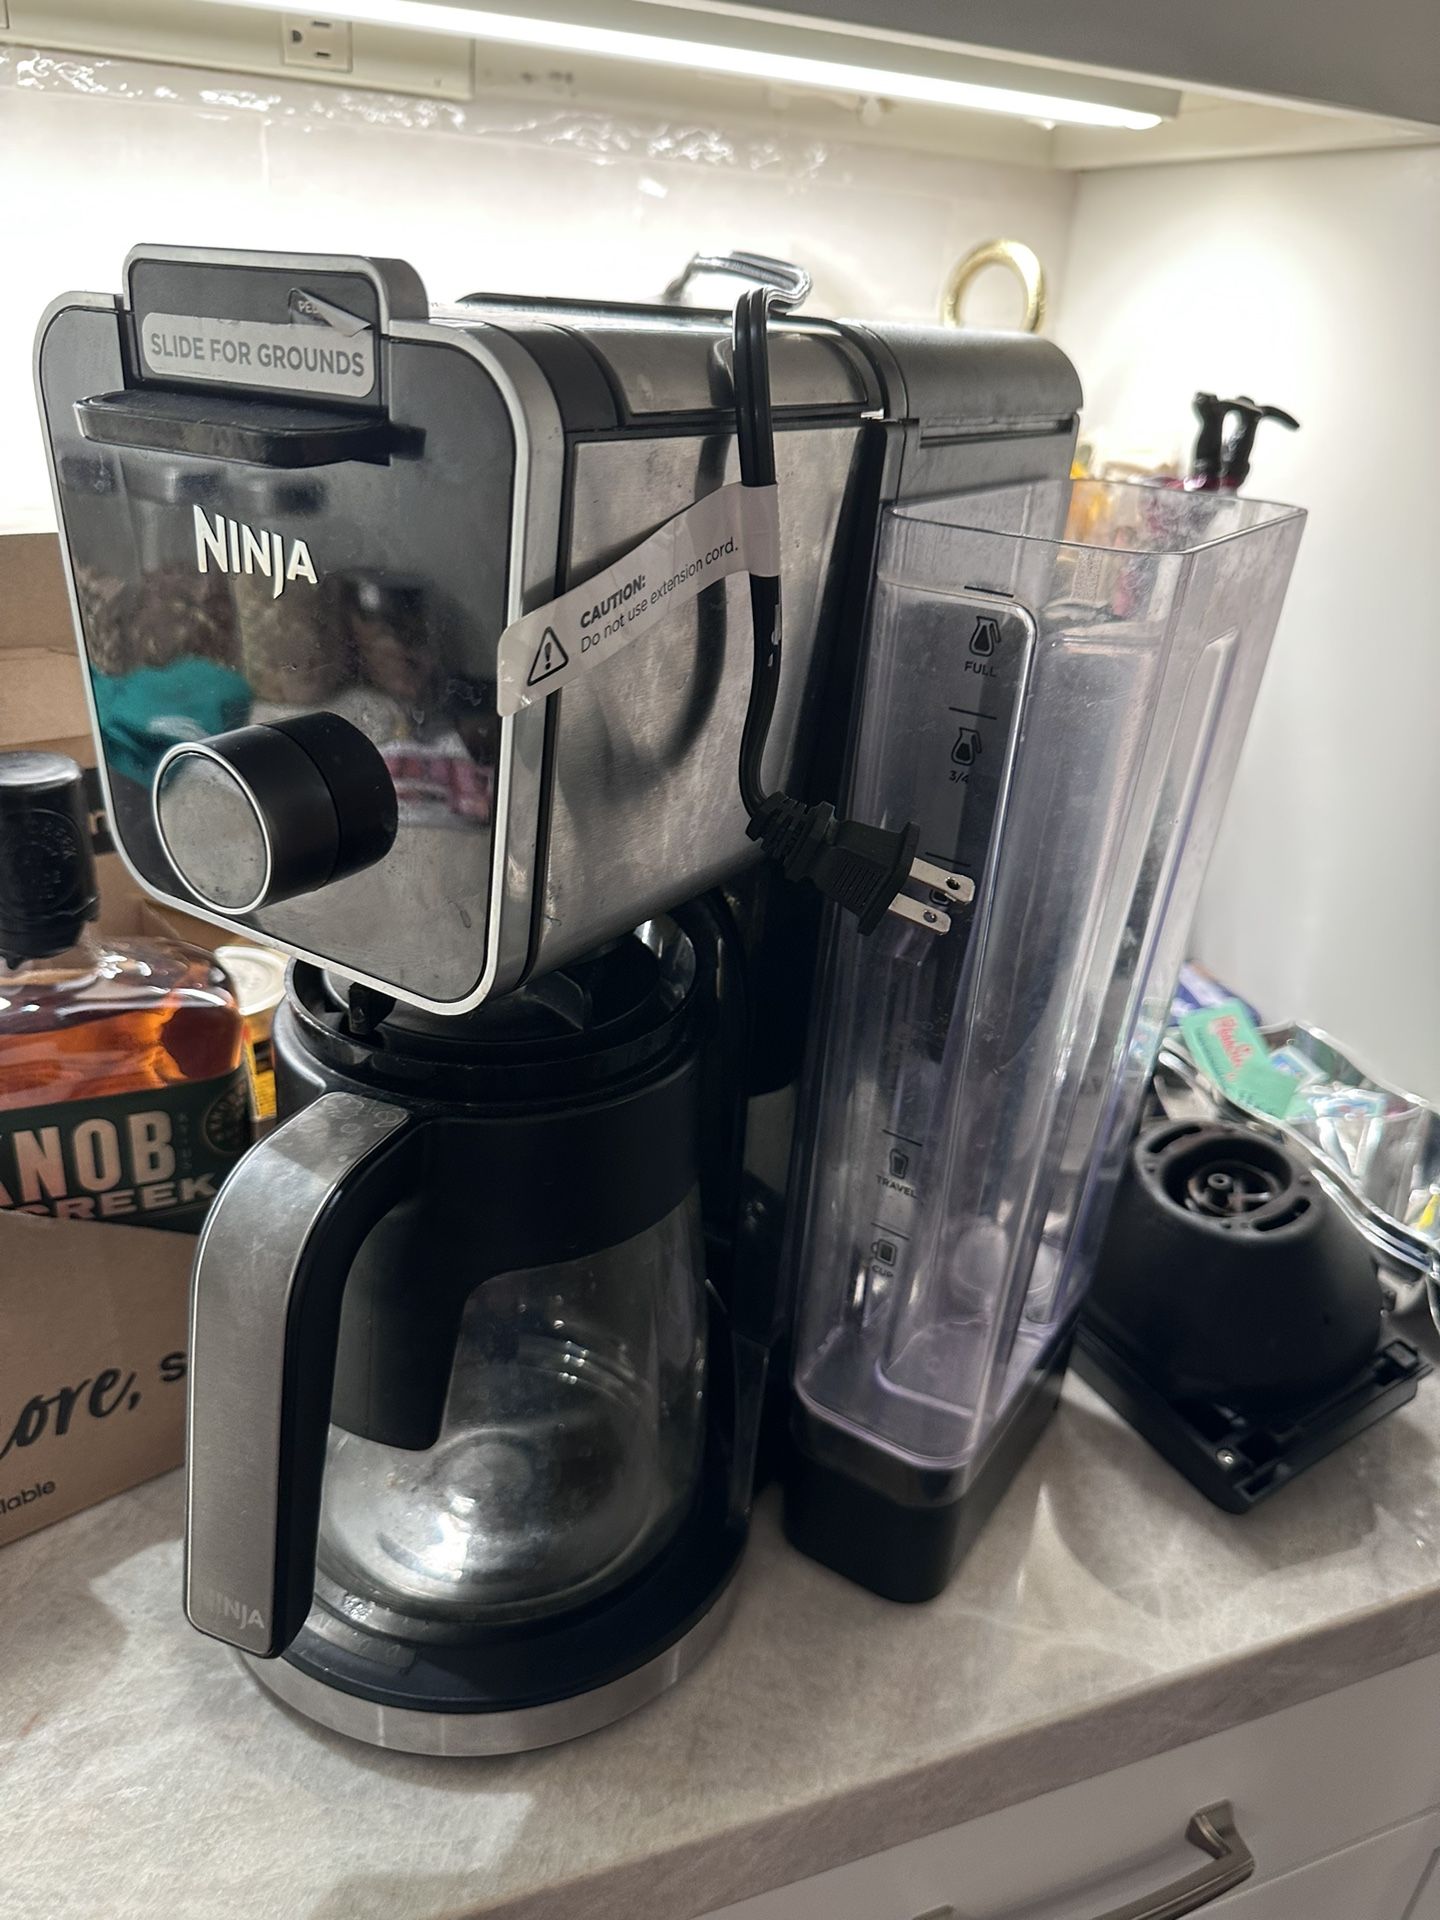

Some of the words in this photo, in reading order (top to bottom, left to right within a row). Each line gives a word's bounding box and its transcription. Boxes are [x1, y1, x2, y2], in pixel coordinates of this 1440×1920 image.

[150, 333, 205, 361] SLIDE
[210, 340, 253, 366] FOR
[257, 343, 364, 377] GROUNDS
[193, 504, 318, 599] NINJA
[580, 632, 601, 653] Do
[603, 613, 625, 639] not
[627, 599, 648, 621] use
[650, 559, 703, 604] extension
[705, 536, 738, 565] cord.
[580, 574, 646, 628] CAUTION:
[963, 661, 997, 678] FULL
[0, 1110, 175, 1206] NOB
[875, 1174, 918, 1199] TRAVEL
[871, 1264, 894, 1279] CUP
[0, 1367, 141, 1461] ore,
[0, 1479, 56, 1515] lable
